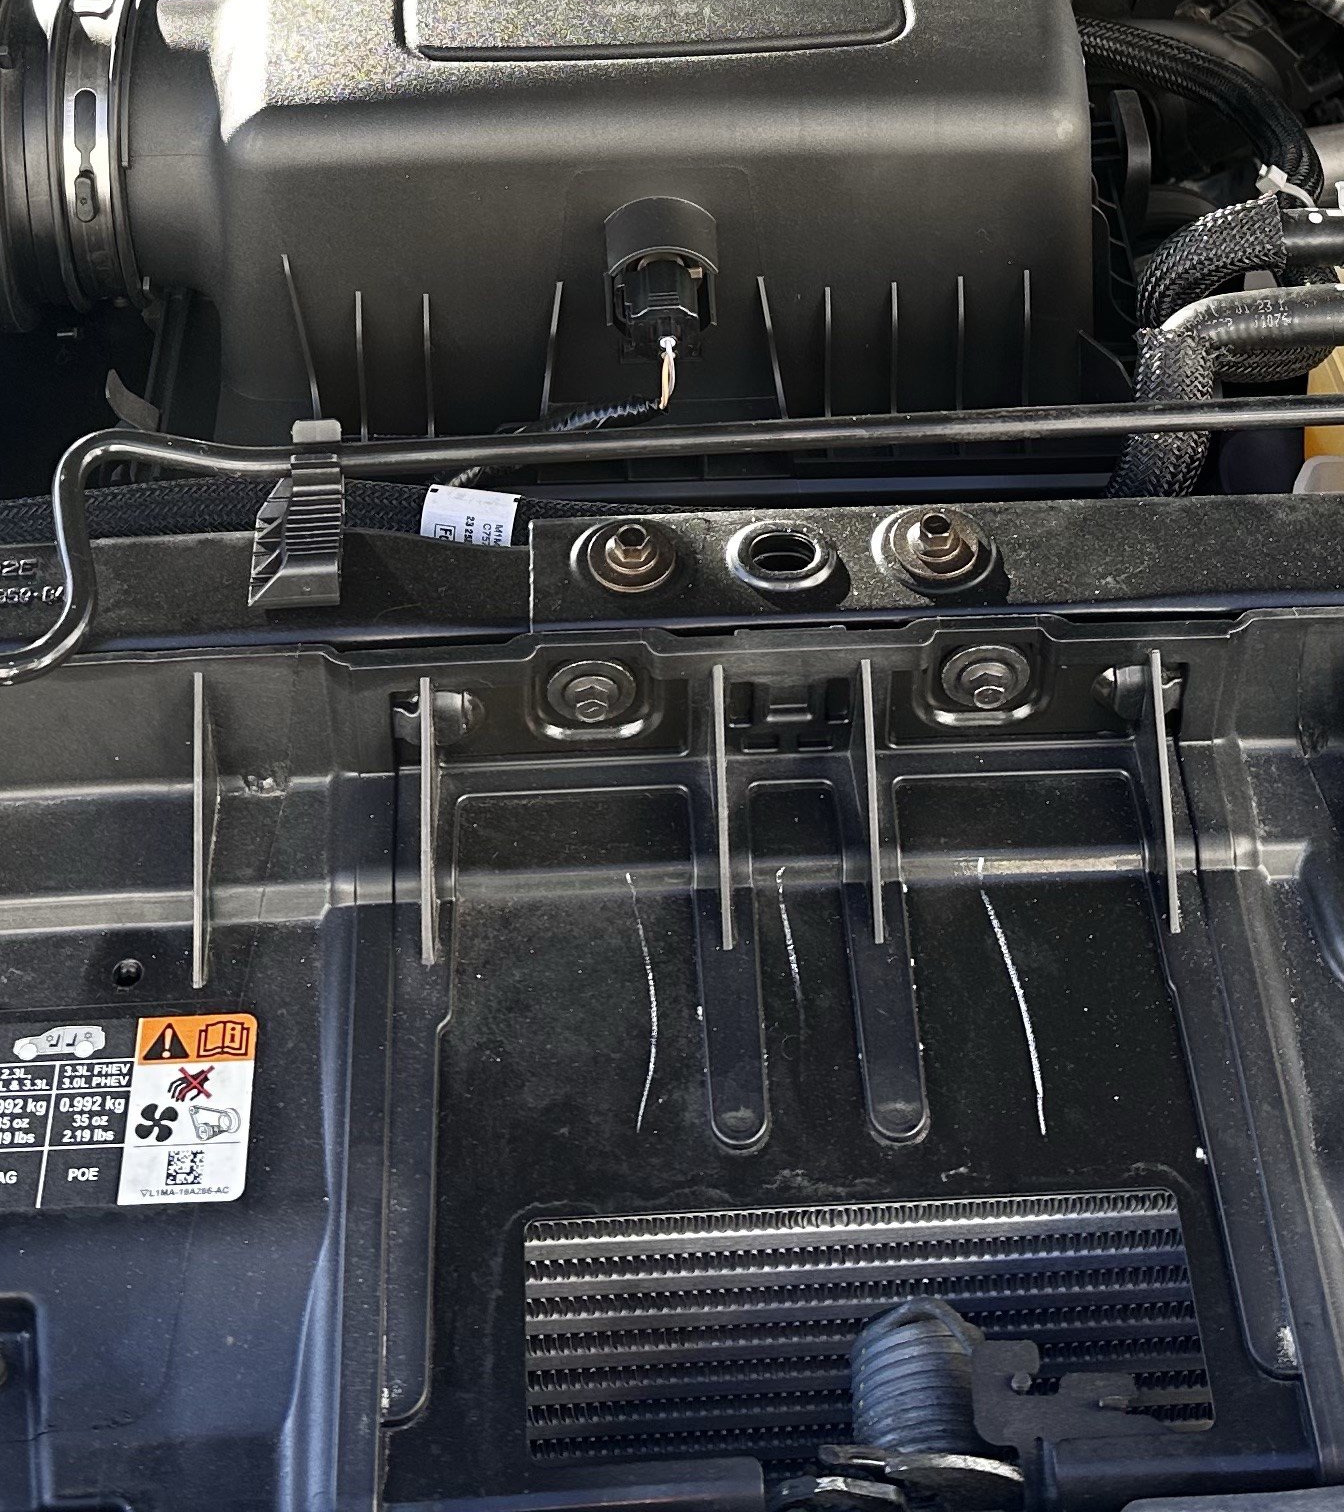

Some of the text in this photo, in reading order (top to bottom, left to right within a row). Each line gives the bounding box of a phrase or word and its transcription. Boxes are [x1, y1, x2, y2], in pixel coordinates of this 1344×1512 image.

[63, 1063, 131, 1076] 3.3L FHEV
[9, 1080, 20, 1091] &
[22, 1079, 50, 1091] 3.3L
[61, 1076, 129, 1089] 3.0L PHEV
[26, 1098, 47, 1116] kg
[59, 1095, 125, 1113] 0.992 kg
[12, 1118, 30, 1129] oz
[71, 1114, 109, 1127] 35 oz
[13, 1131, 35, 1144] lbs
[61, 1129, 115, 1143] 2.19 lbs
[67, 1167, 99, 1182] POE
